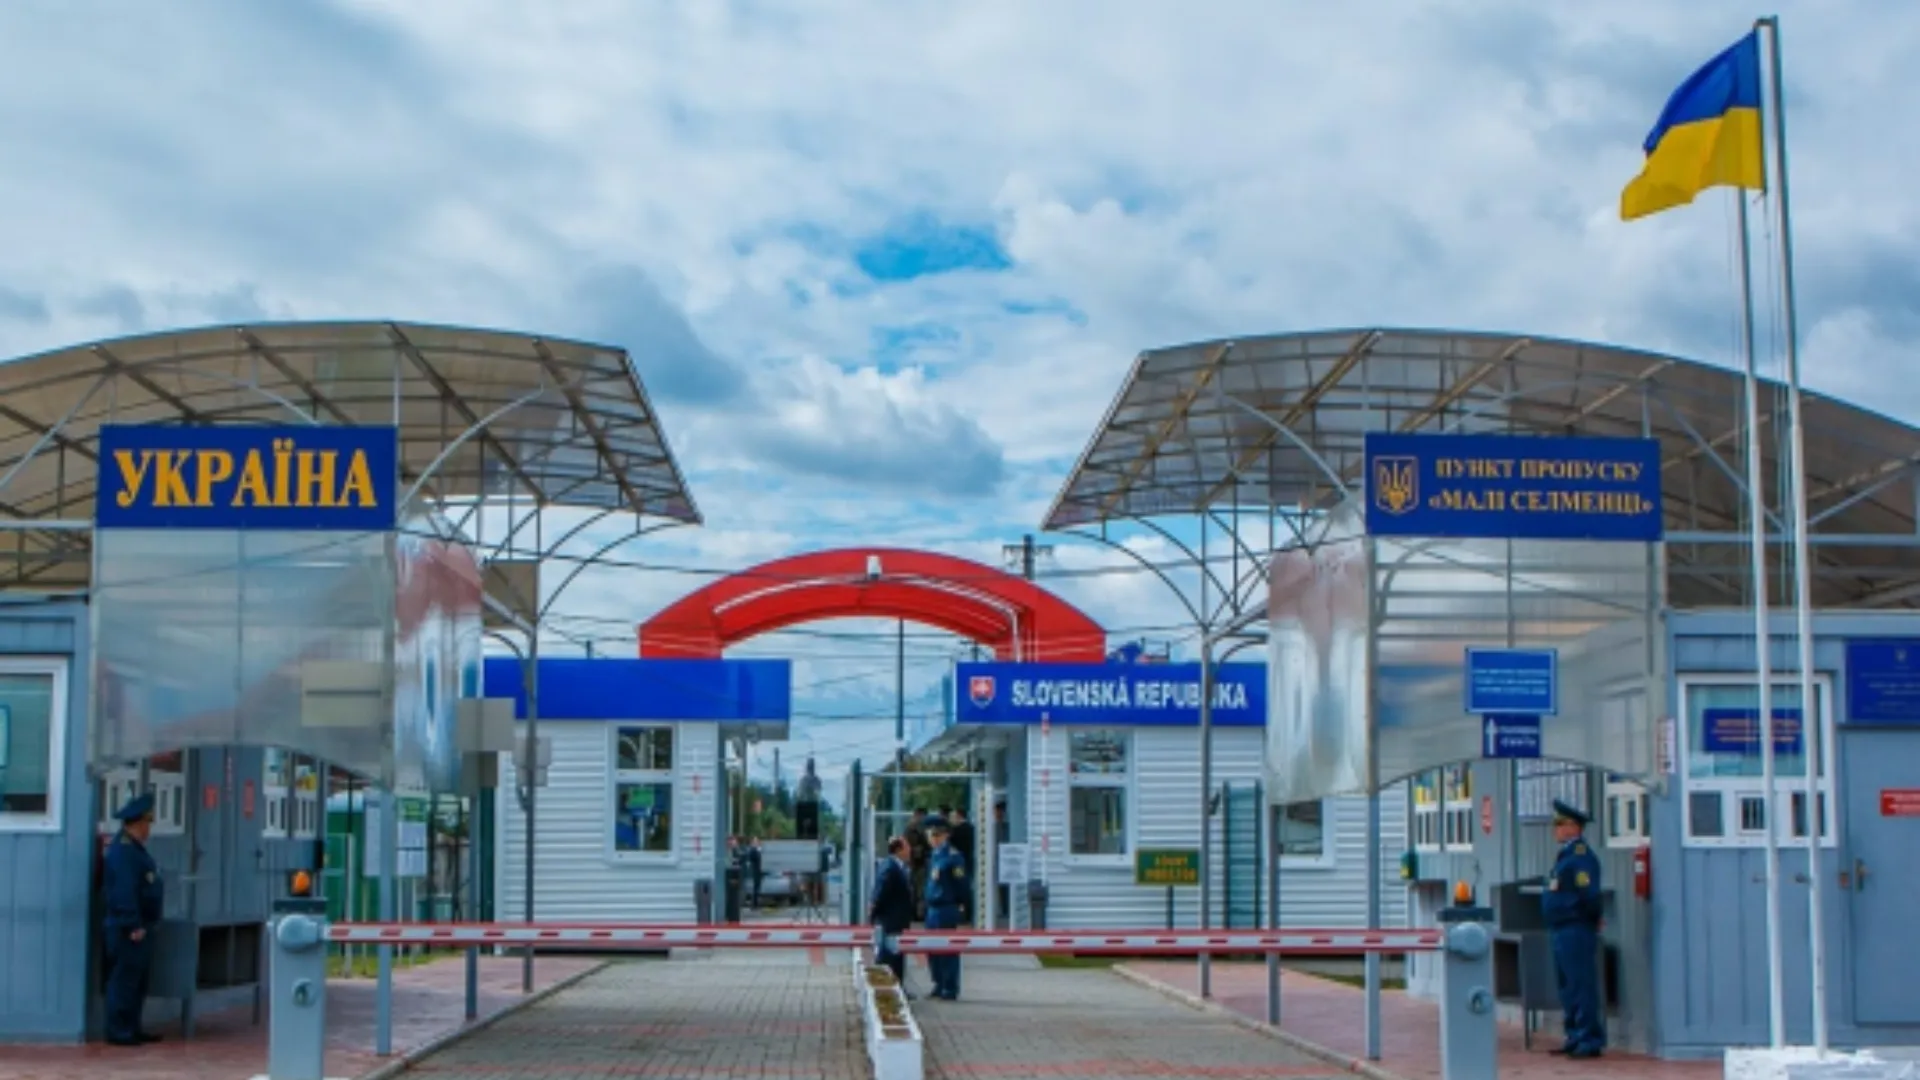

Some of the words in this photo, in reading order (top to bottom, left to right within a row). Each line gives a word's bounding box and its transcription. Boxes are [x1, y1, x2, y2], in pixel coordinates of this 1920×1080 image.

[113, 438, 377, 507] УКРАЇНА
[1436, 458, 1514, 477] ПУНКТ
[1521, 459, 1643, 480] ПРОПУСКУ
[1428, 489, 1505, 510] «МАЛІ
[1011, 676, 1130, 707] SLOVENSKÁ
[1134, 681, 1247, 709] REPUBIKA
